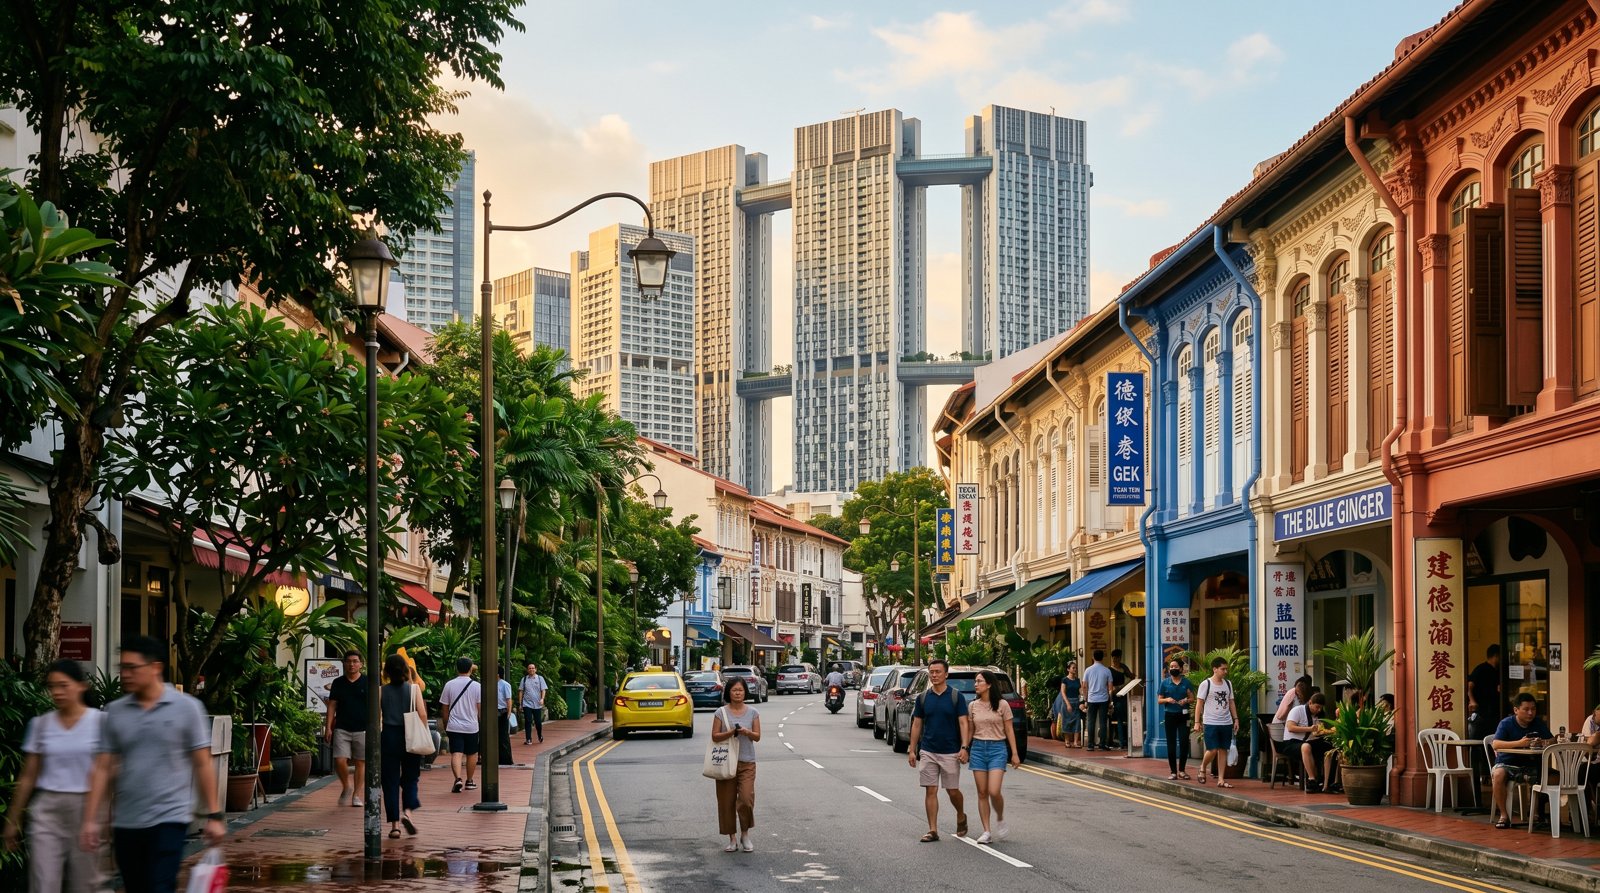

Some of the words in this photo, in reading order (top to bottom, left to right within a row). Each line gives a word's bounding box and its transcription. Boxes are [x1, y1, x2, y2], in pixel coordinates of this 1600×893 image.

[1113, 466, 1140, 481] GEK
[1282, 510, 1303, 535] THE
[1305, 503, 1334, 531] BLUE
[1337, 491, 1384, 524] GINGER
[1274, 627, 1297, 640] BLUE
[1272, 645, 1299, 656] GINGER
